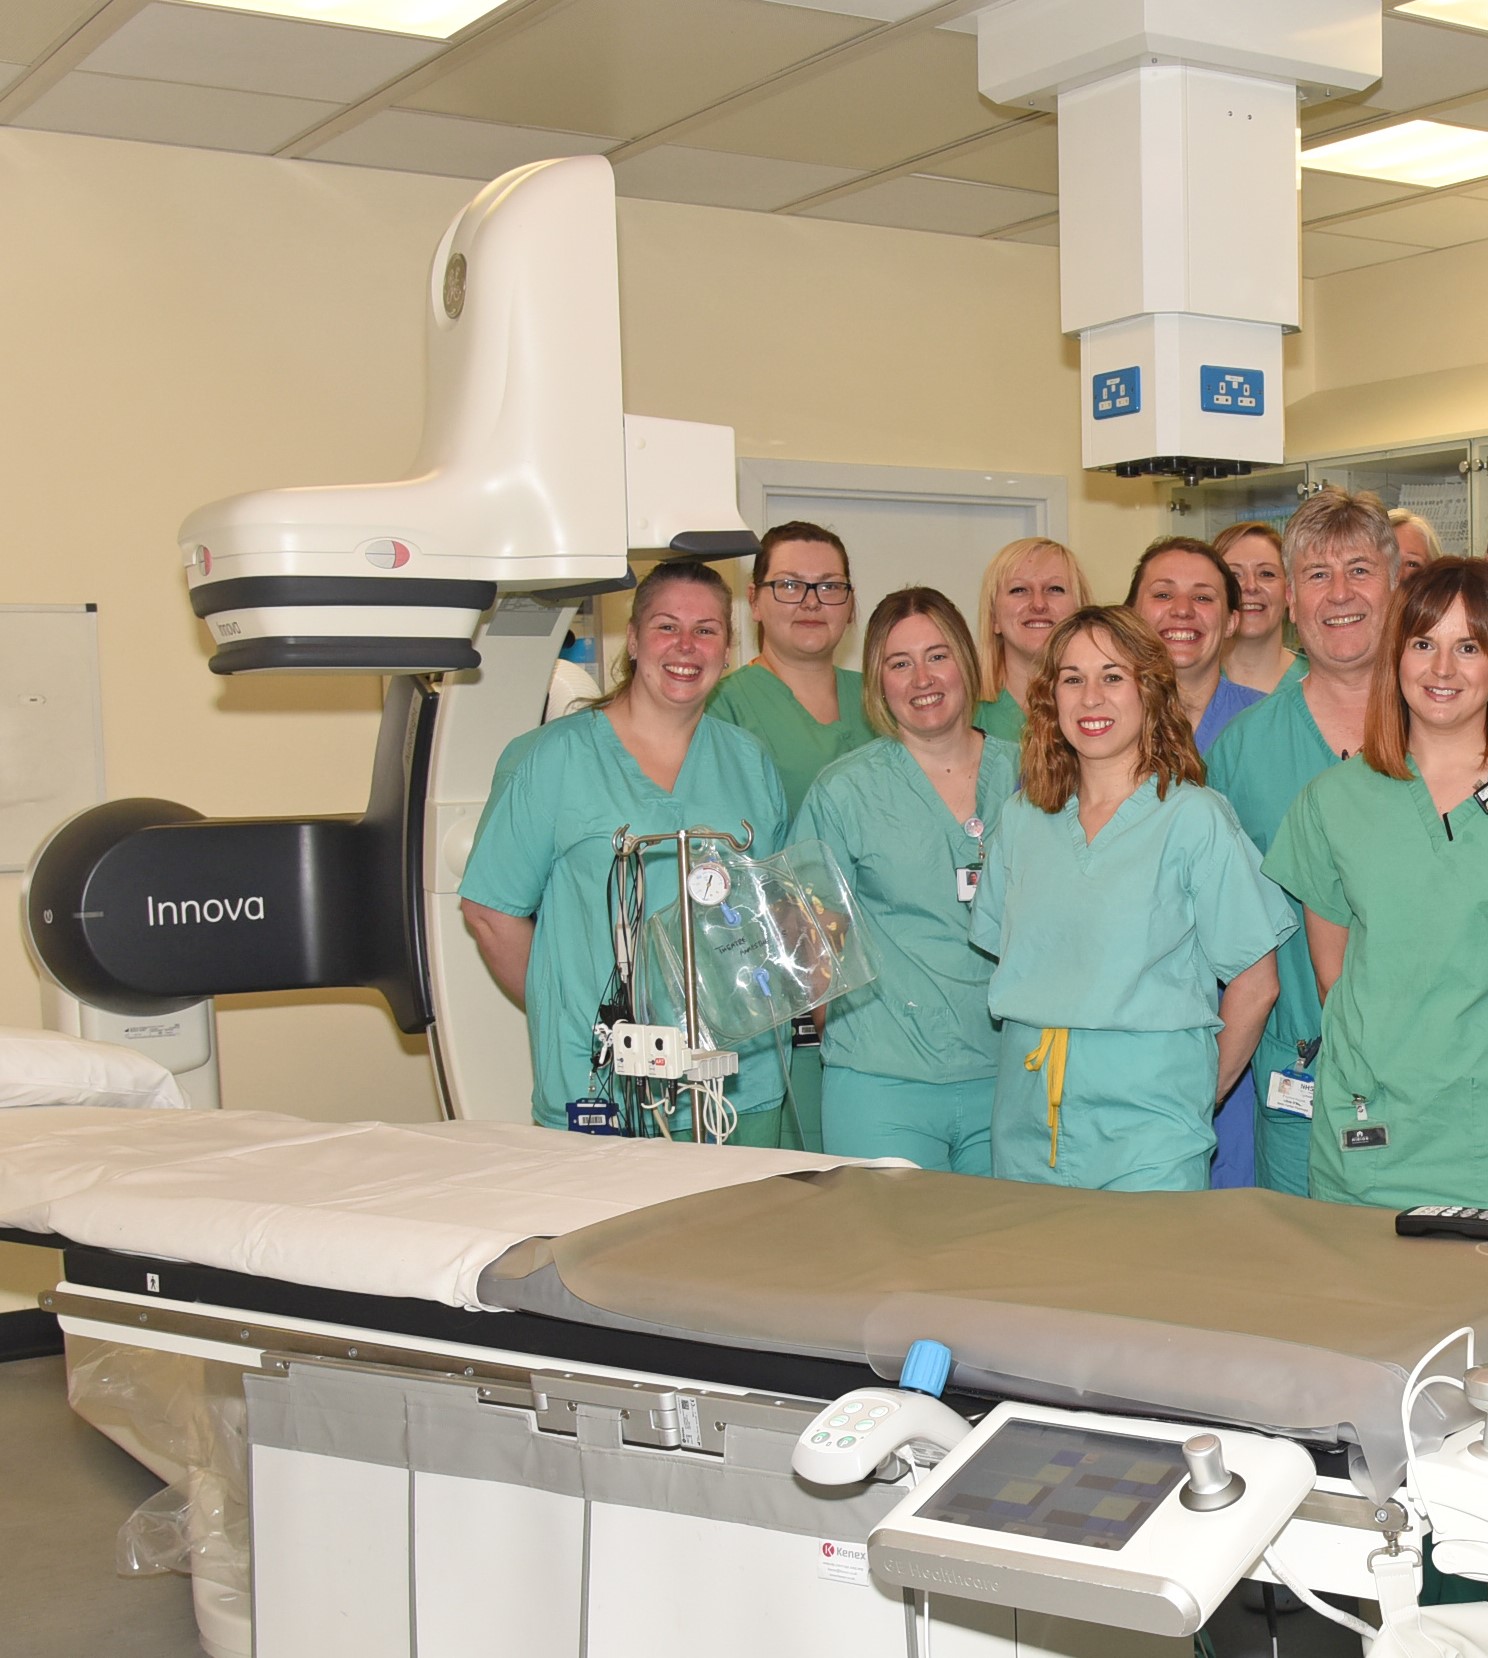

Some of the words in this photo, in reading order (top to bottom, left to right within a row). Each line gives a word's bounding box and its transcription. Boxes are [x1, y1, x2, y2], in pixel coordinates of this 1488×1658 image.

[147, 896, 264, 926] Innova
[837, 1547, 866, 1560] Kenex
[908, 1561, 999, 1592] Healthcare
